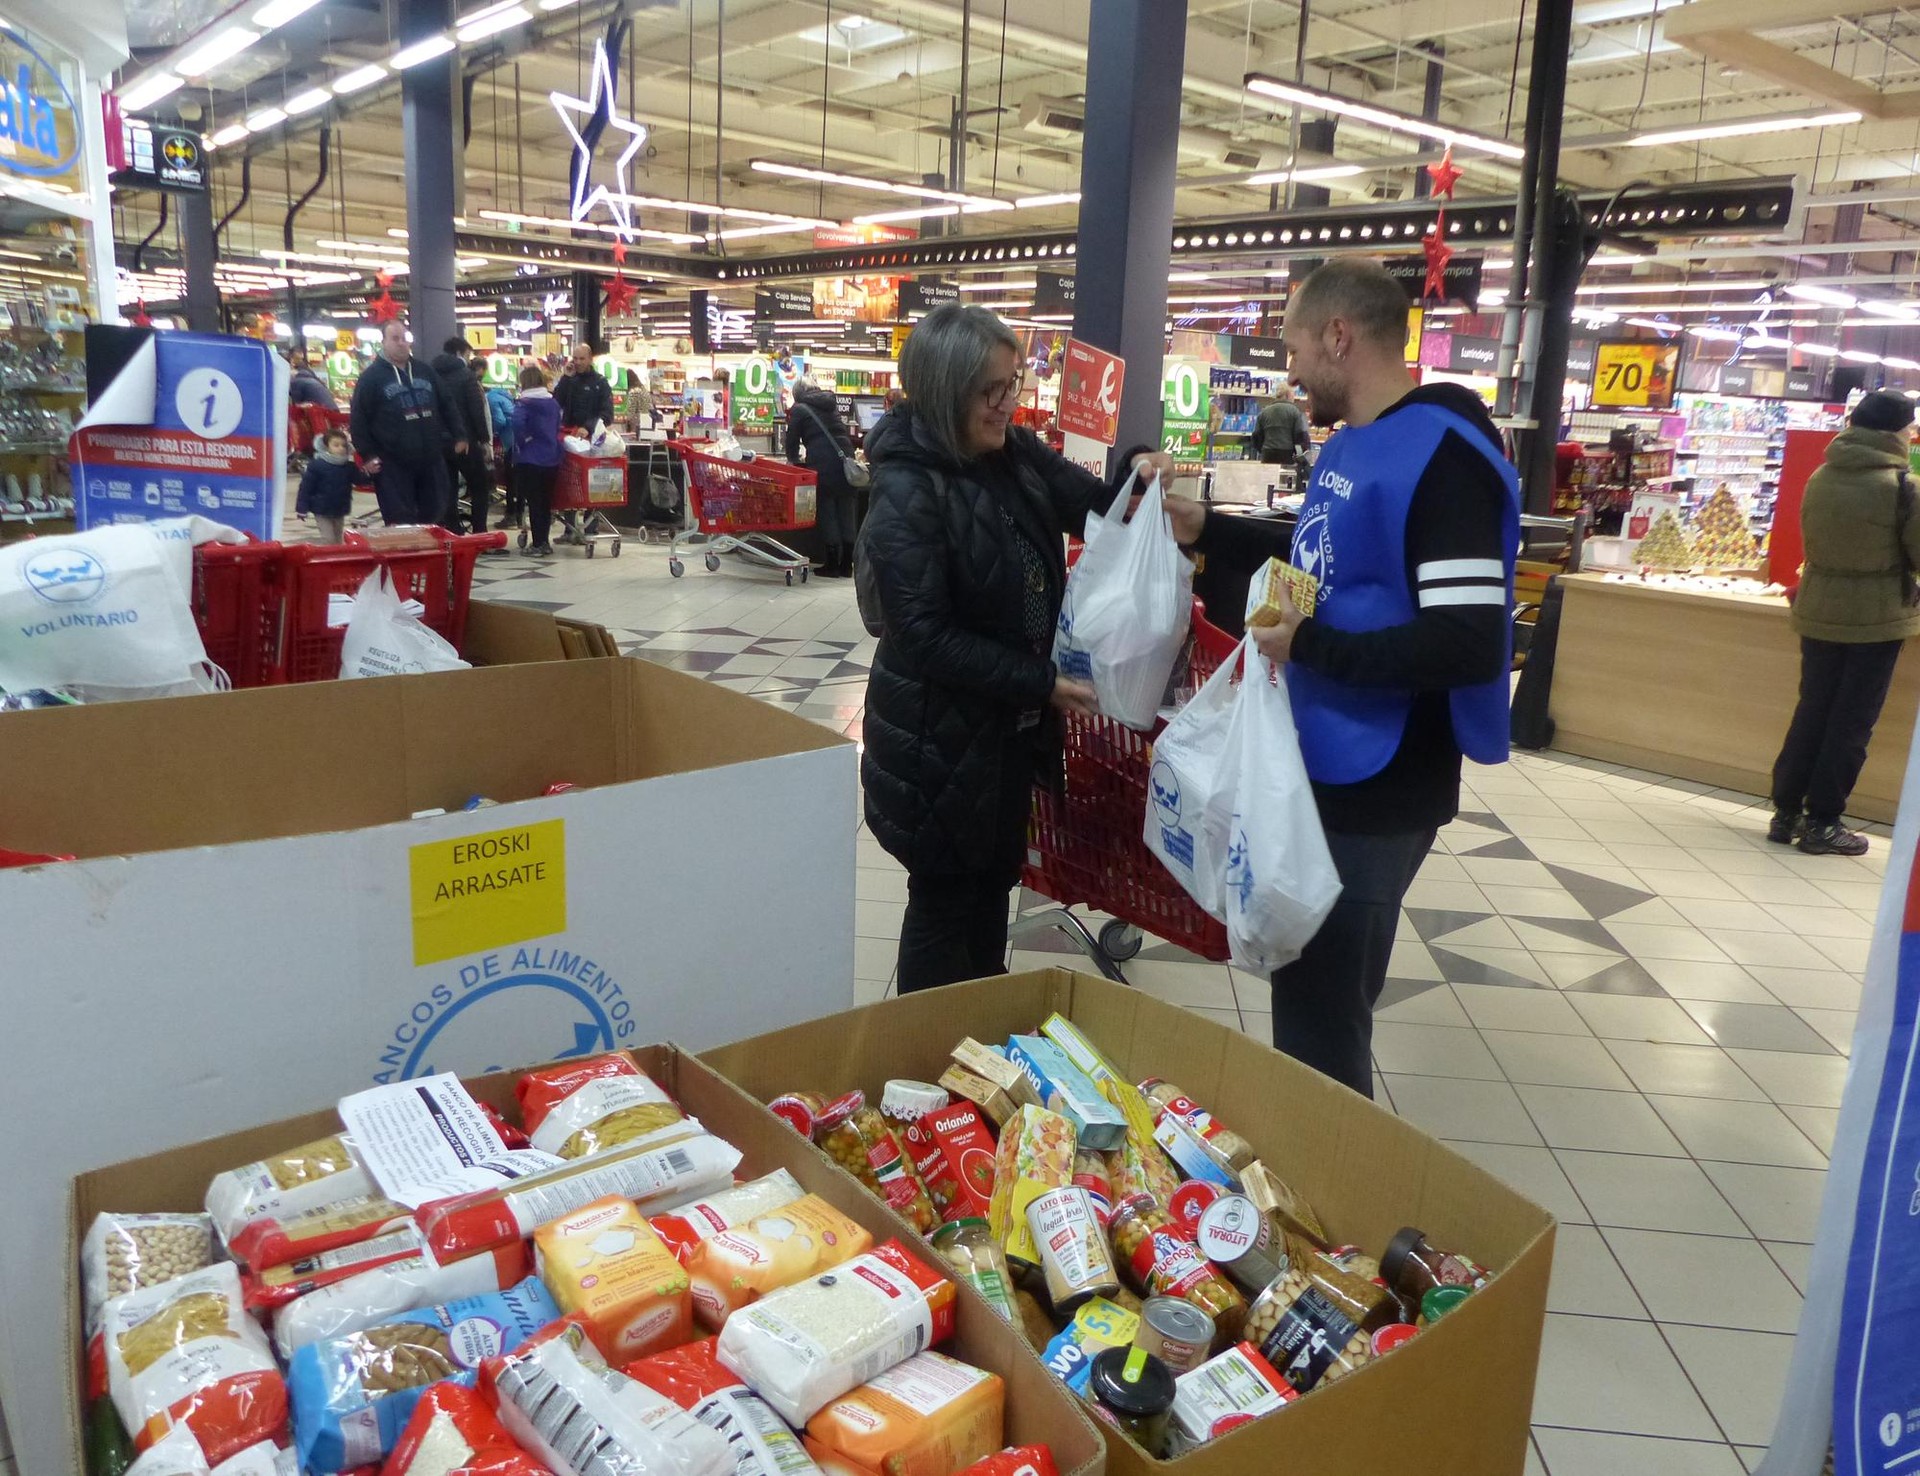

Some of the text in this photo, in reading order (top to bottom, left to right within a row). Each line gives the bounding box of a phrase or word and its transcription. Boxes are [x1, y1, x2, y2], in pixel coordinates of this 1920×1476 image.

[775, 292, 791, 302] Caja
[920, 285, 934, 297] Caja
[745, 357, 767, 394] 0
[739, 407, 757, 422] 24
[152, 438, 180, 454] PARA
[181, 439, 207, 456] ESTA
[1164, 435, 1183, 456] 24
[1302, 580, 1316, 615] CALDO
[22, 609, 139, 638] VOLUNTARIO
[453, 832, 530, 865] EROSKI
[434, 861, 547, 902] ARRASATE
[373, 947, 636, 1084] ANCOS DE ALIMENTOS
[559, 1075, 584, 1094] basic
[1009, 1047, 1042, 1092] Calvo
[443, 1080, 466, 1109] BANCO
[465, 1108, 476, 1121] DE
[439, 1093, 457, 1116] GRAN
[457, 1116, 486, 1162] RECOGIDA
[935, 1112, 976, 1133] Orlando
[434, 1113, 468, 1164] PRODUCTOS
[916, 1147, 942, 1173] Orlando
[562, 1205, 621, 1236] Azucarera
[702, 1207, 727, 1233] redondo
[712, 1233, 769, 1266] Azucarera
[1208, 1227, 1249, 1247] LITORAL
[1153, 1244, 1195, 1276] luengo
[861, 1270, 892, 1292] redondo
[626, 1308, 673, 1344] Azucarera
[1284, 1318, 1312, 1351] alubias
[462, 1335, 475, 1363] FIBRA
[481, 1333, 495, 1358] ALTO
